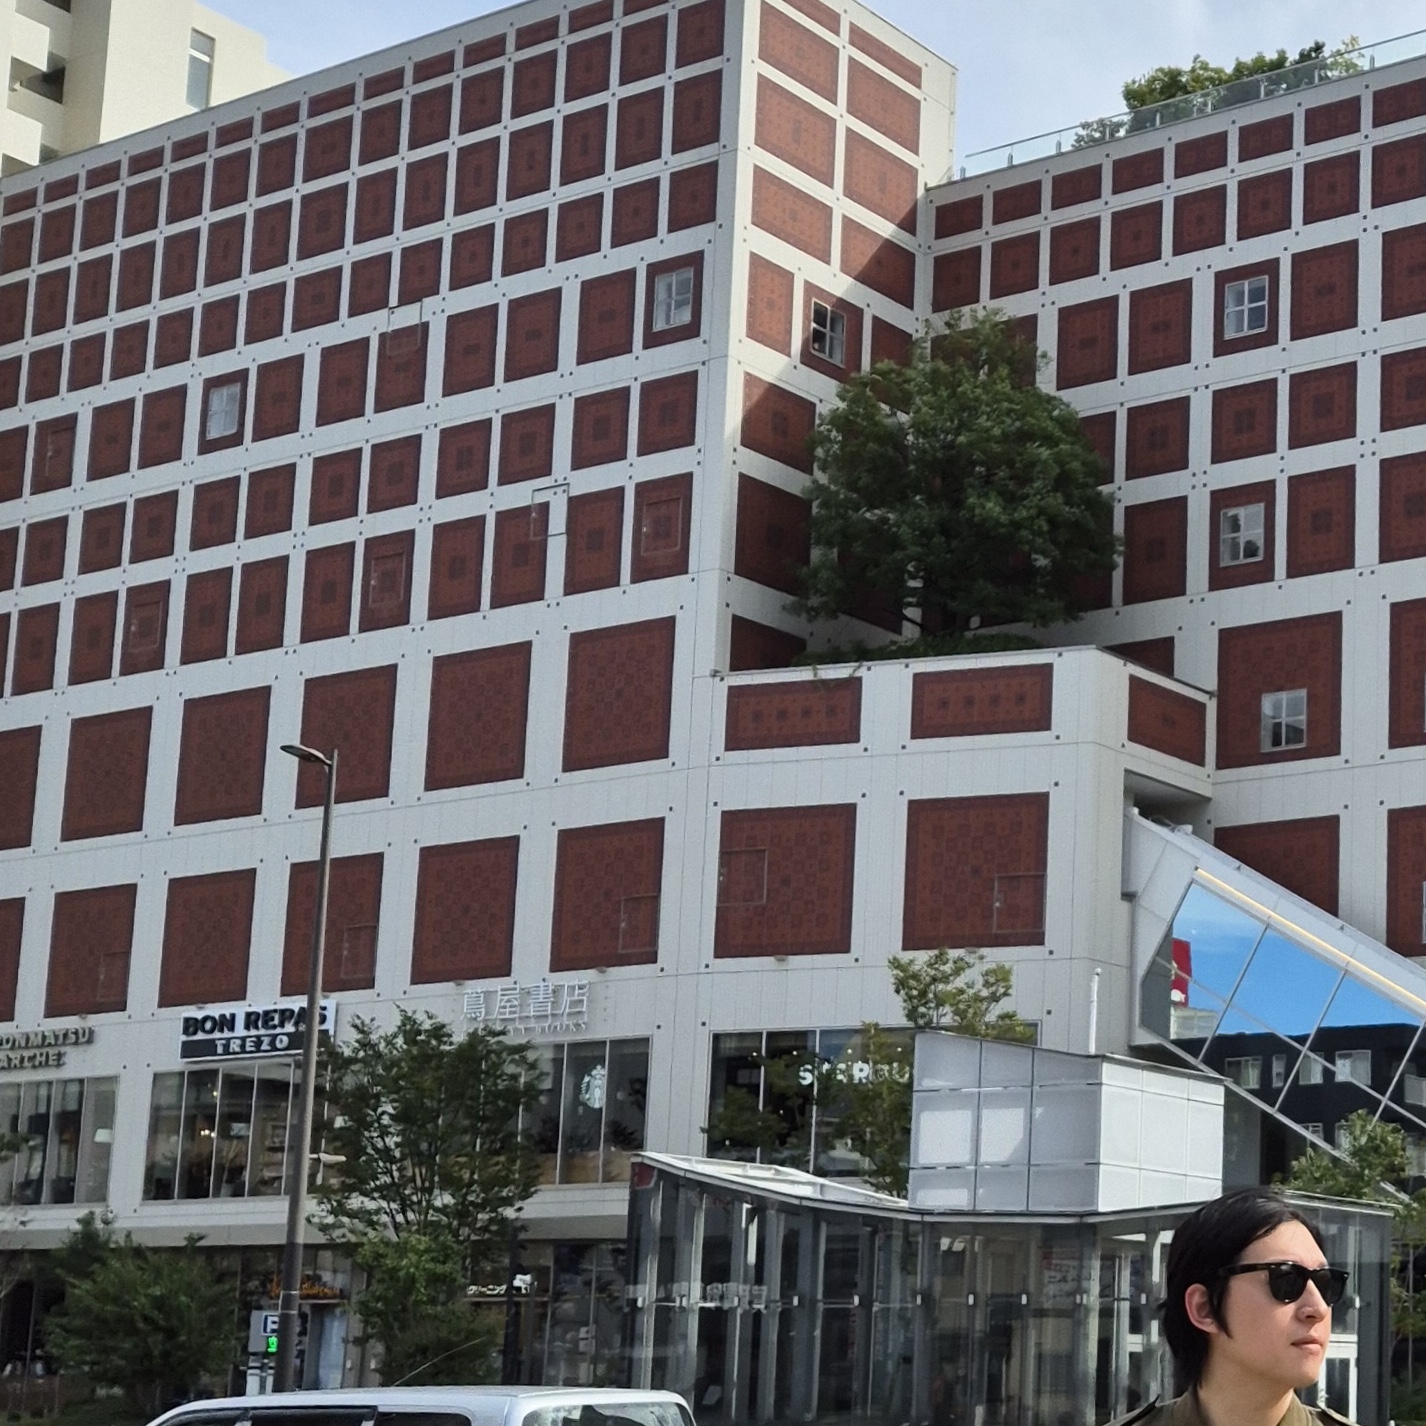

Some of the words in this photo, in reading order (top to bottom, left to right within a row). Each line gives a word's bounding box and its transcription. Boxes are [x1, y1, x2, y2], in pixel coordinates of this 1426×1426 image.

[461, 979, 589, 1021] 蔦屋書店
[182, 1011, 236, 1036] BON
[0, 1026, 93, 1050] ONMATSU
[215, 1034, 290, 1055] TREZO
